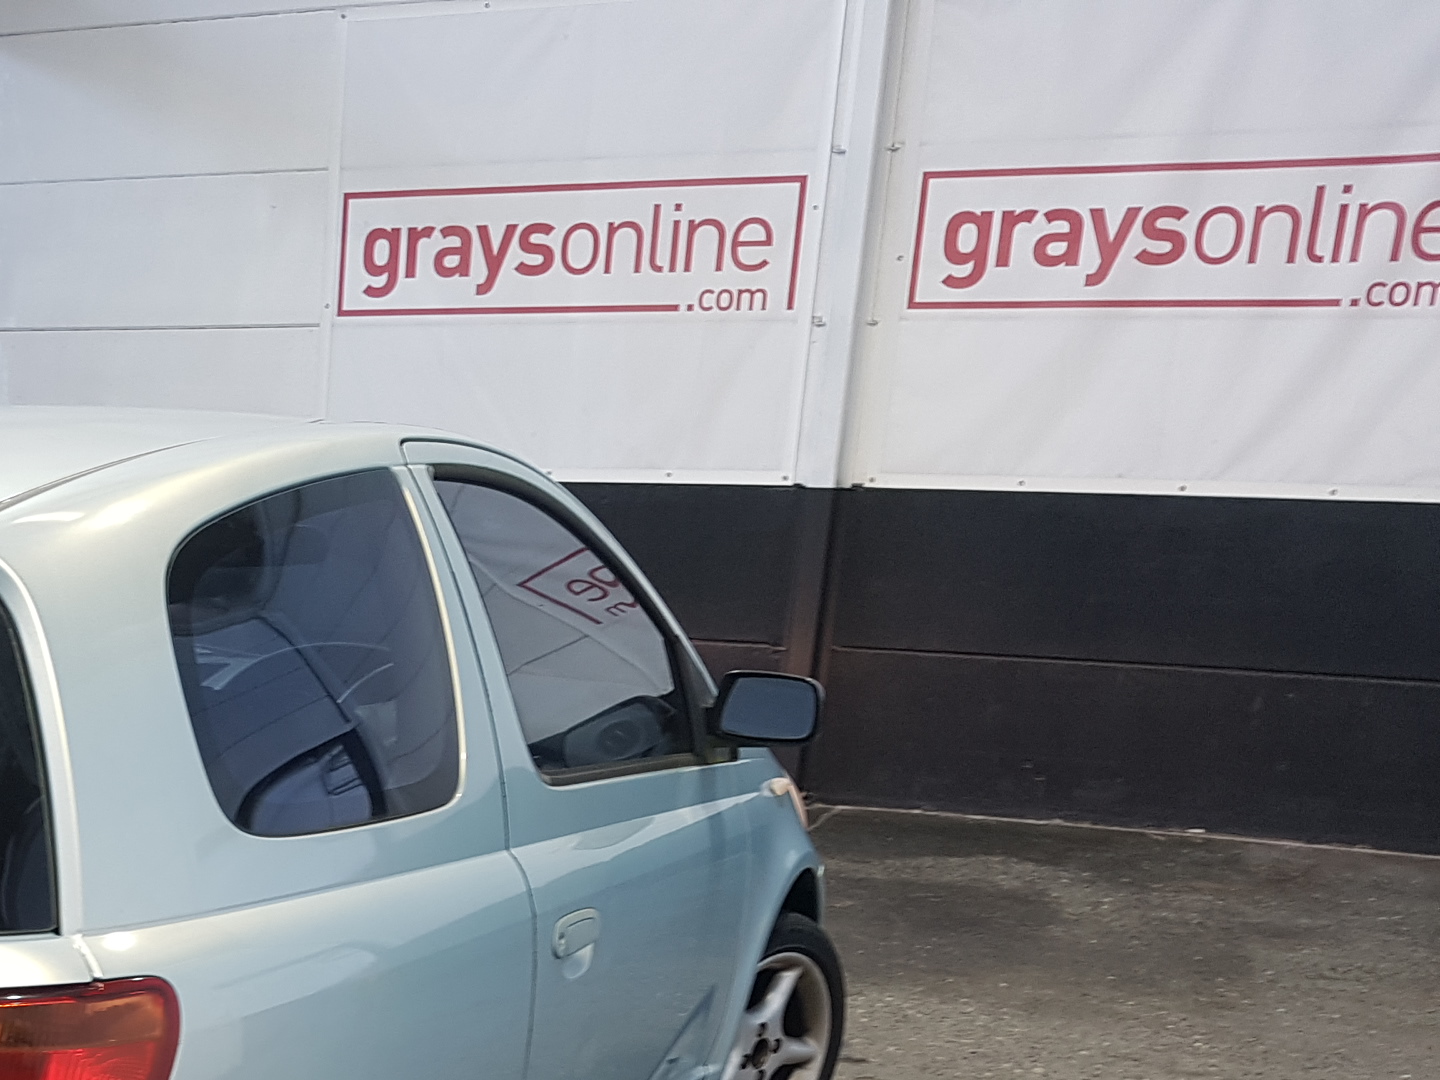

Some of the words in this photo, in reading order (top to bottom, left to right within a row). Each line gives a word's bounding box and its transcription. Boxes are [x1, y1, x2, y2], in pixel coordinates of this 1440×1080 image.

[362, 203, 774, 298] graysonline
[941, 184, 1440, 290] graysonline
[686, 286, 768, 312] .com
[1350, 281, 1440, 307] .com
